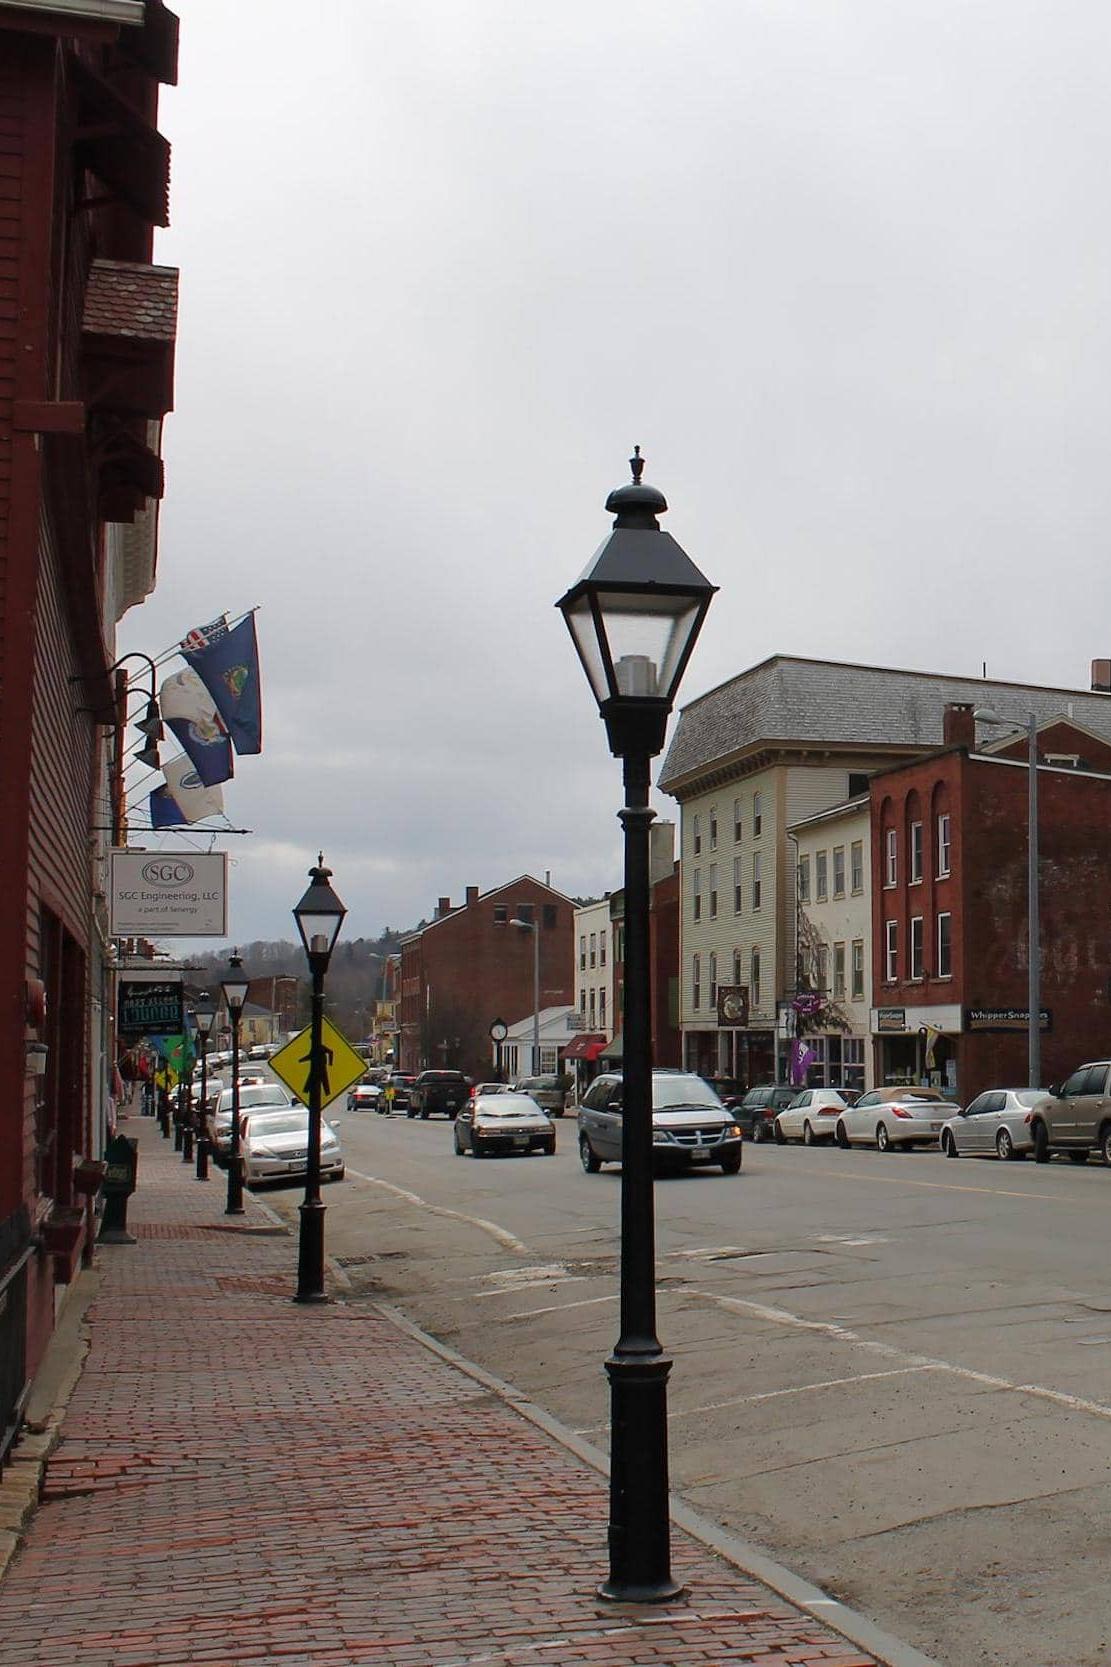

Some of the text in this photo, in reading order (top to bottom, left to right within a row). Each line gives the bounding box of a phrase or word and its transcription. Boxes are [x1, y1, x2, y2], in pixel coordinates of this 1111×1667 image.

[150, 866, 187, 881] SGC
[119, 891, 220, 902] SGC Engineering, LLC
